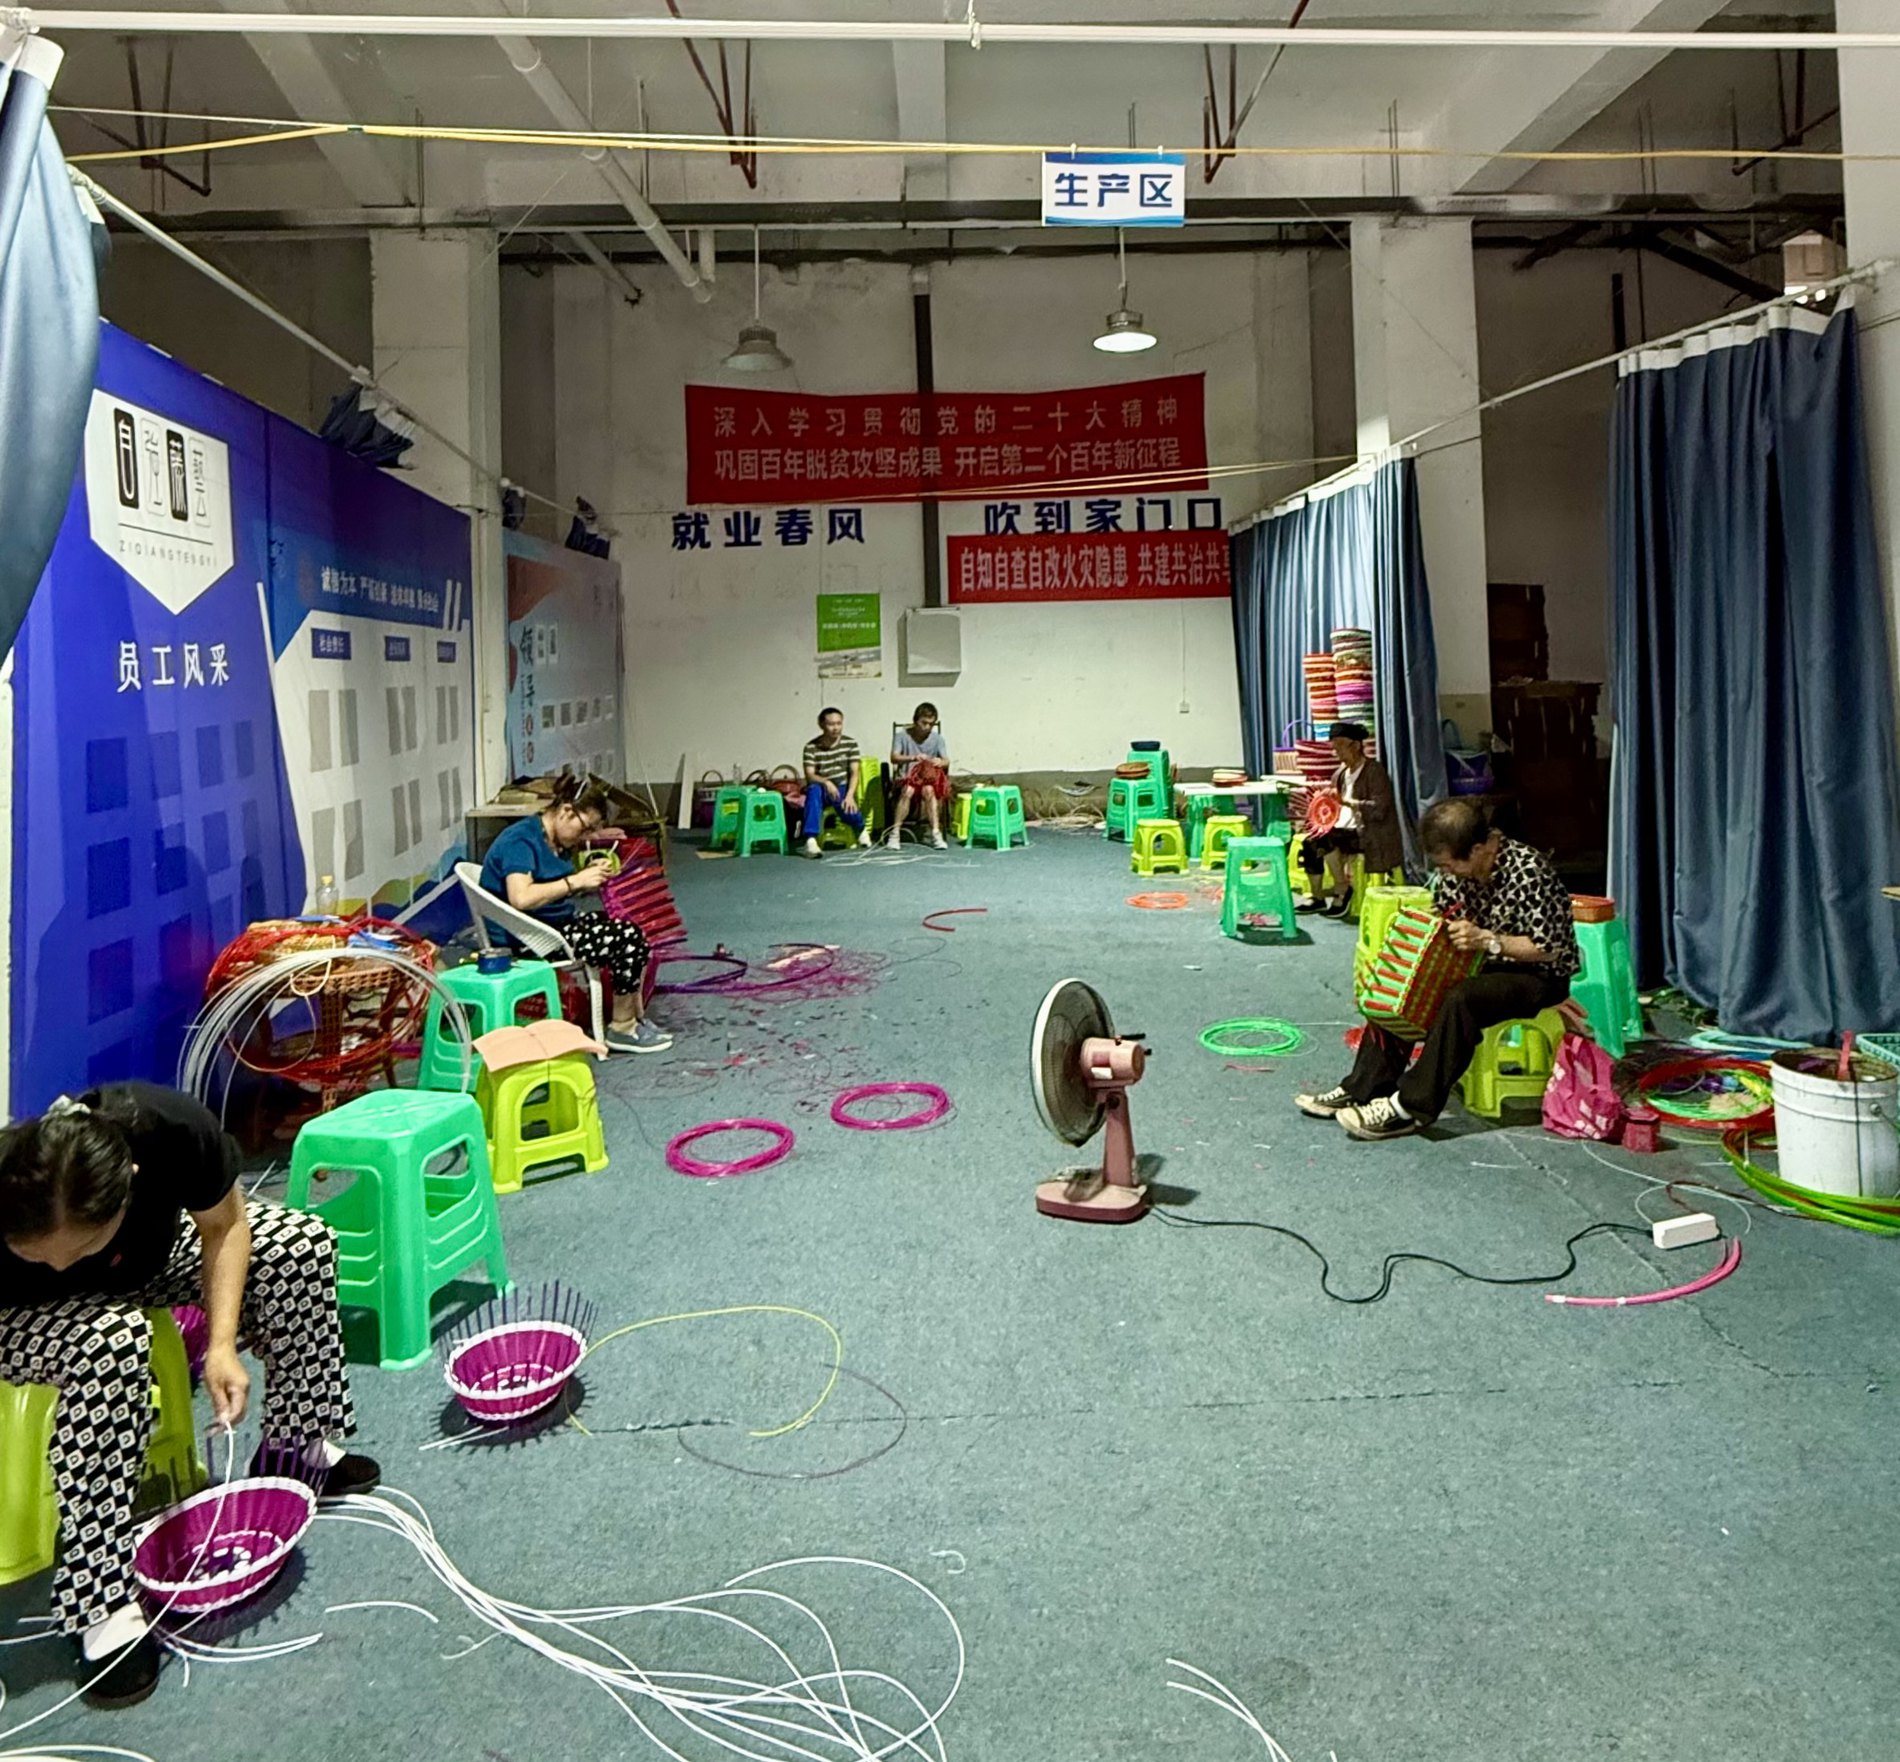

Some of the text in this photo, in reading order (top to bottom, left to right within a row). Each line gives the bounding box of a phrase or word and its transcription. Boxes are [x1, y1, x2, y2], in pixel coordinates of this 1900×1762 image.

[1055, 172, 1173, 208] 生产区
[713, 394, 1178, 438] 深入学习贯彻党的二十大精神
[714, 437, 1182, 481] 巩固百年脱贫攻坚成果 开启第二个百年新征程
[671, 497, 1222, 550] 就业春风 吹到家门口
[960, 543, 1129, 592] 自知自查自改火灾隐患
[116, 640, 230, 693] 员工风采
